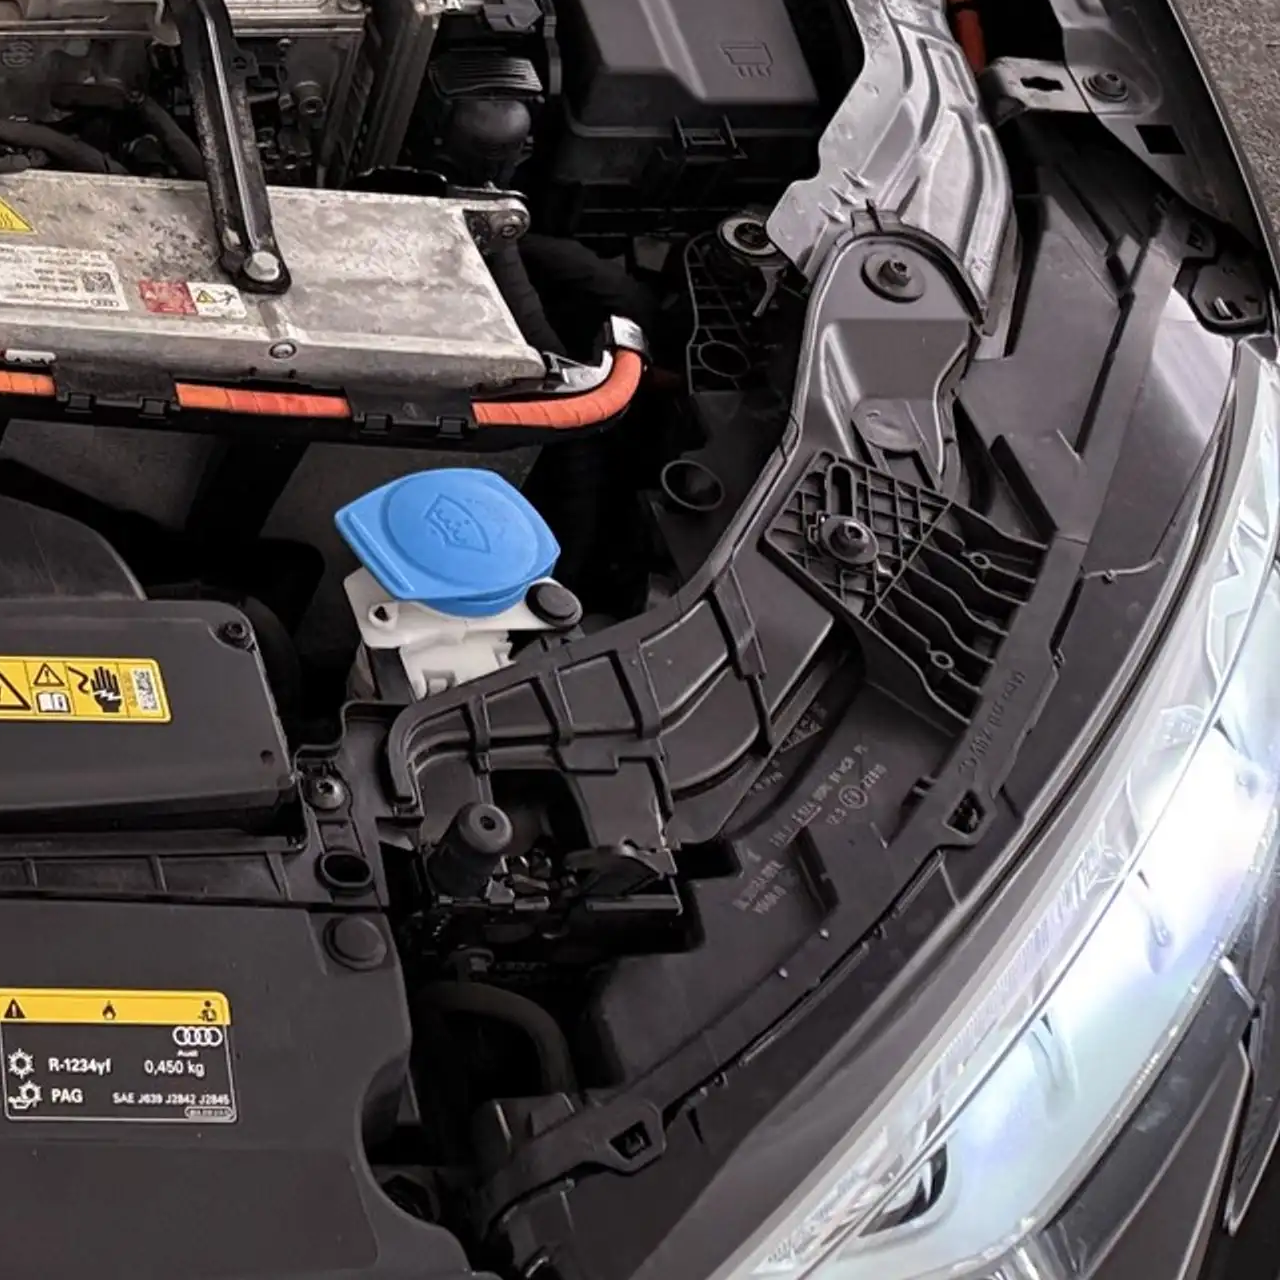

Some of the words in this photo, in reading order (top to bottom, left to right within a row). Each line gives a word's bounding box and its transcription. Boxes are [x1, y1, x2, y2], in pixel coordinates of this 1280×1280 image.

[144, 1059, 184, 1076] 0,450
[187, 1059, 205, 1078] kg
[51, 1088, 84, 1104] PAG
[112, 1091, 136, 1104] SAE
